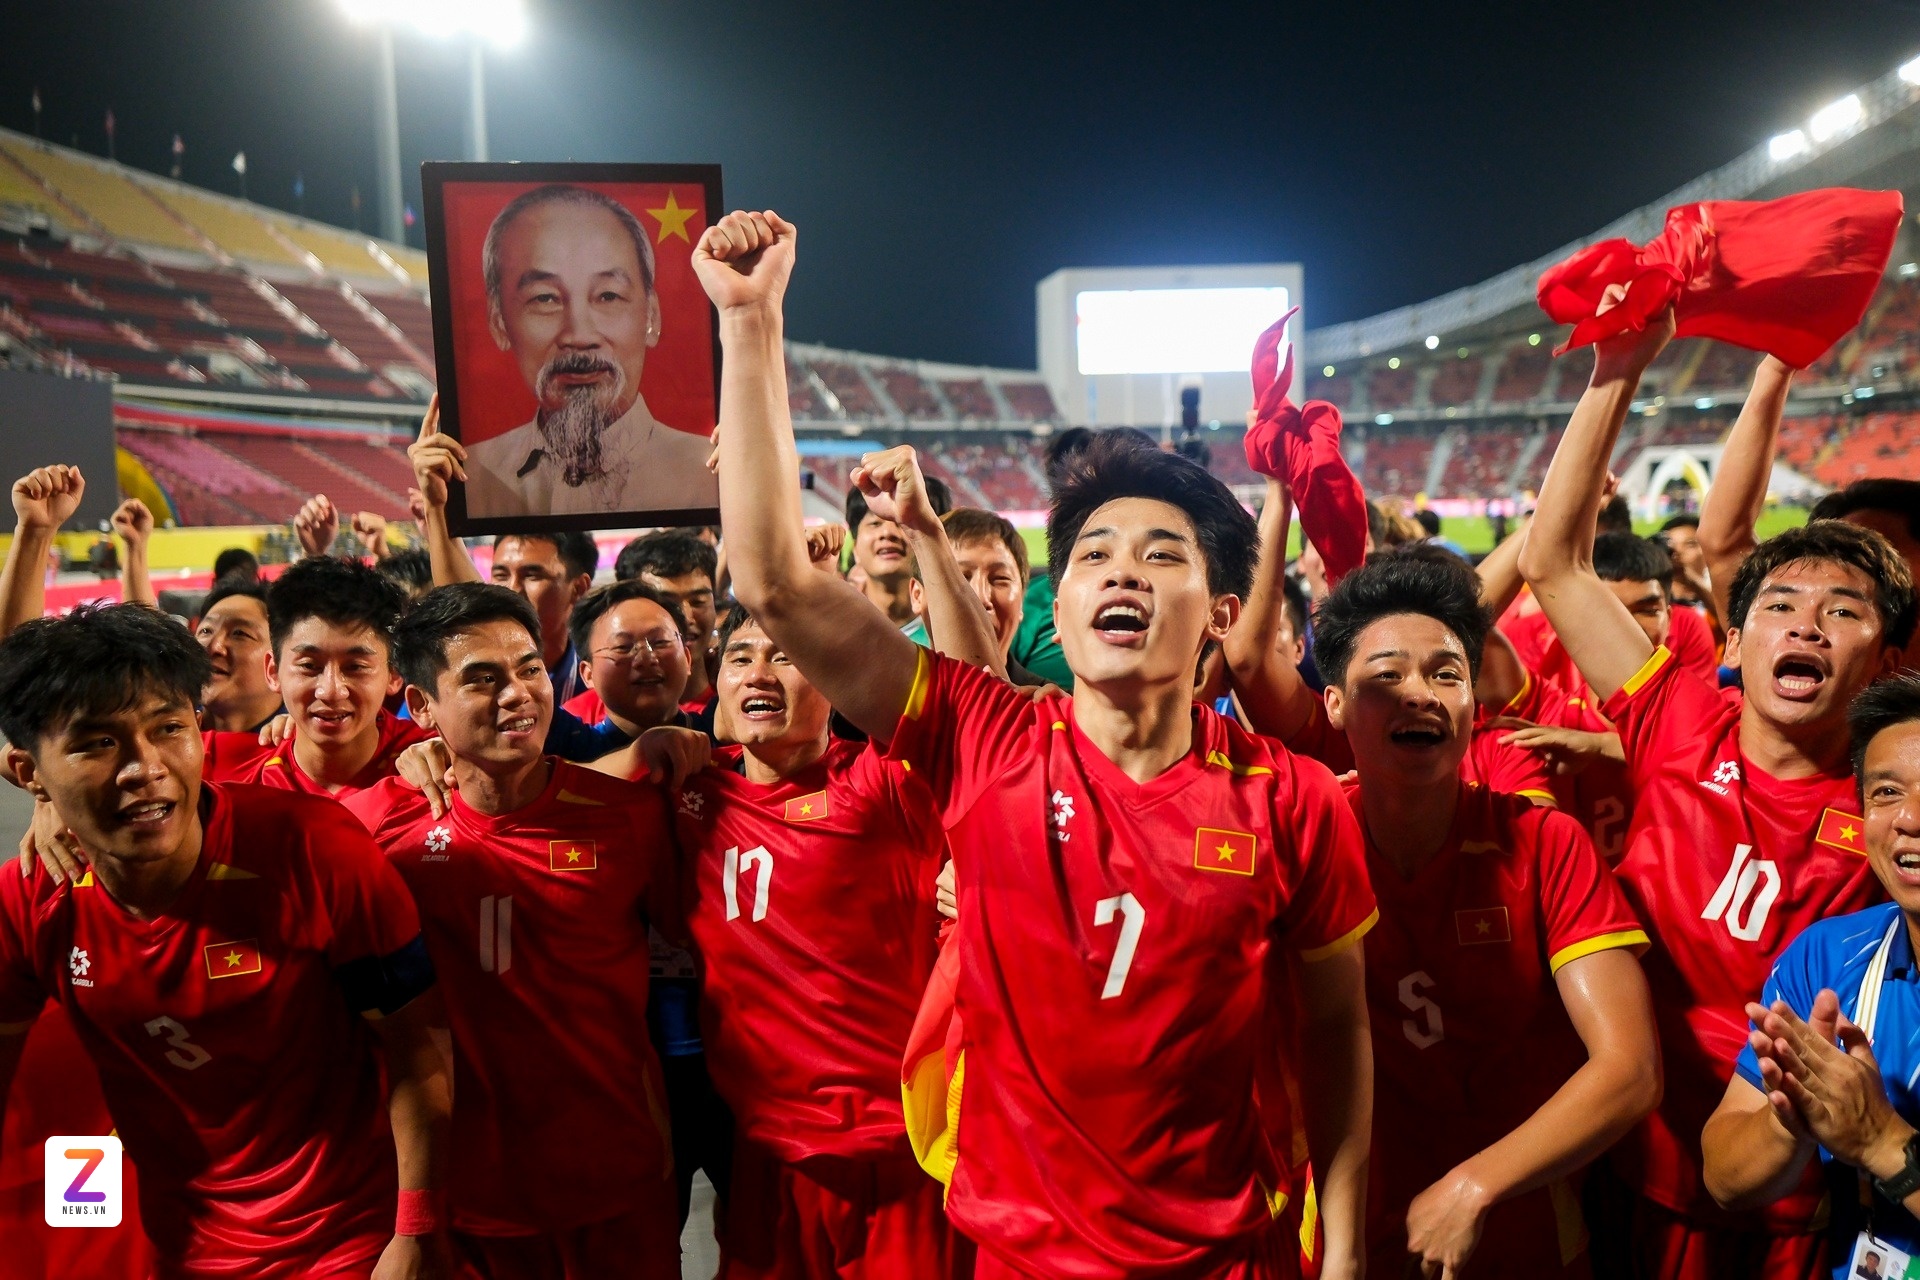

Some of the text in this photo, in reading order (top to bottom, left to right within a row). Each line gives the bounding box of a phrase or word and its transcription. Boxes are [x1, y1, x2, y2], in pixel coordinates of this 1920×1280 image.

[722, 845, 774, 922] 17
[1701, 843, 1782, 942] 10
[479, 895, 513, 976] 11
[1094, 892, 1146, 1000] 7
[144, 1015, 212, 1071] 3
[1398, 970, 1444, 1050] 5
